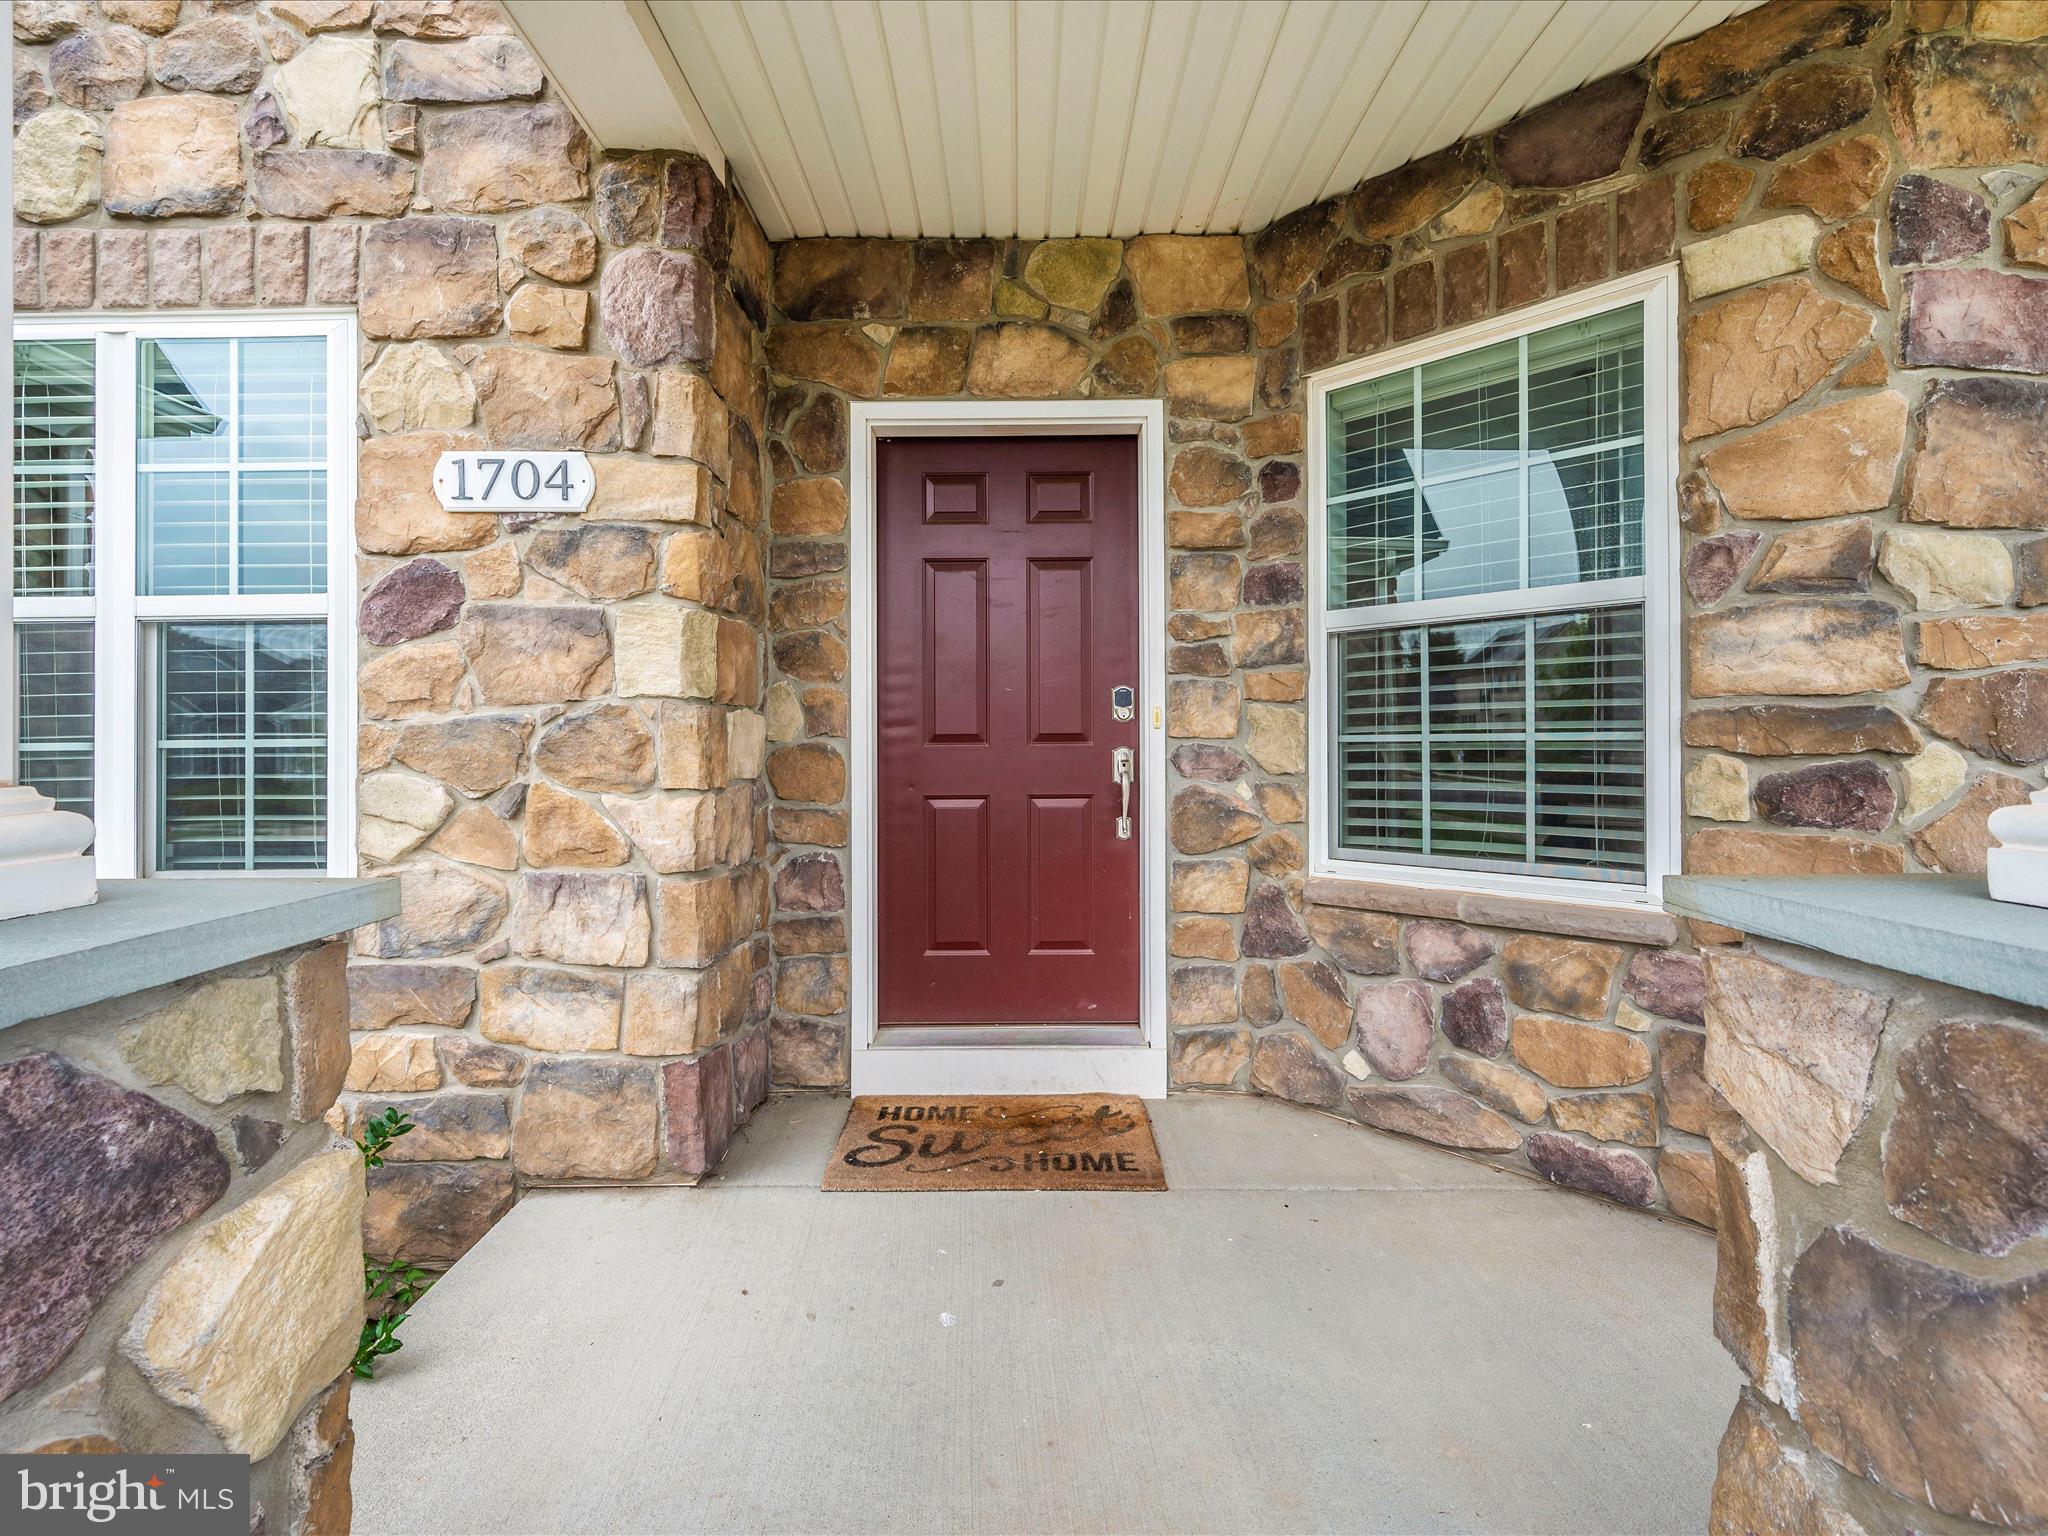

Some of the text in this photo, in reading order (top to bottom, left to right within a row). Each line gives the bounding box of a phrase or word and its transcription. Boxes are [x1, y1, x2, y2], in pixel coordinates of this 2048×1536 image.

[451, 458, 575, 501] 1704
[877, 1105, 980, 1122] HOME
[1023, 1152, 1140, 1172] HOME
